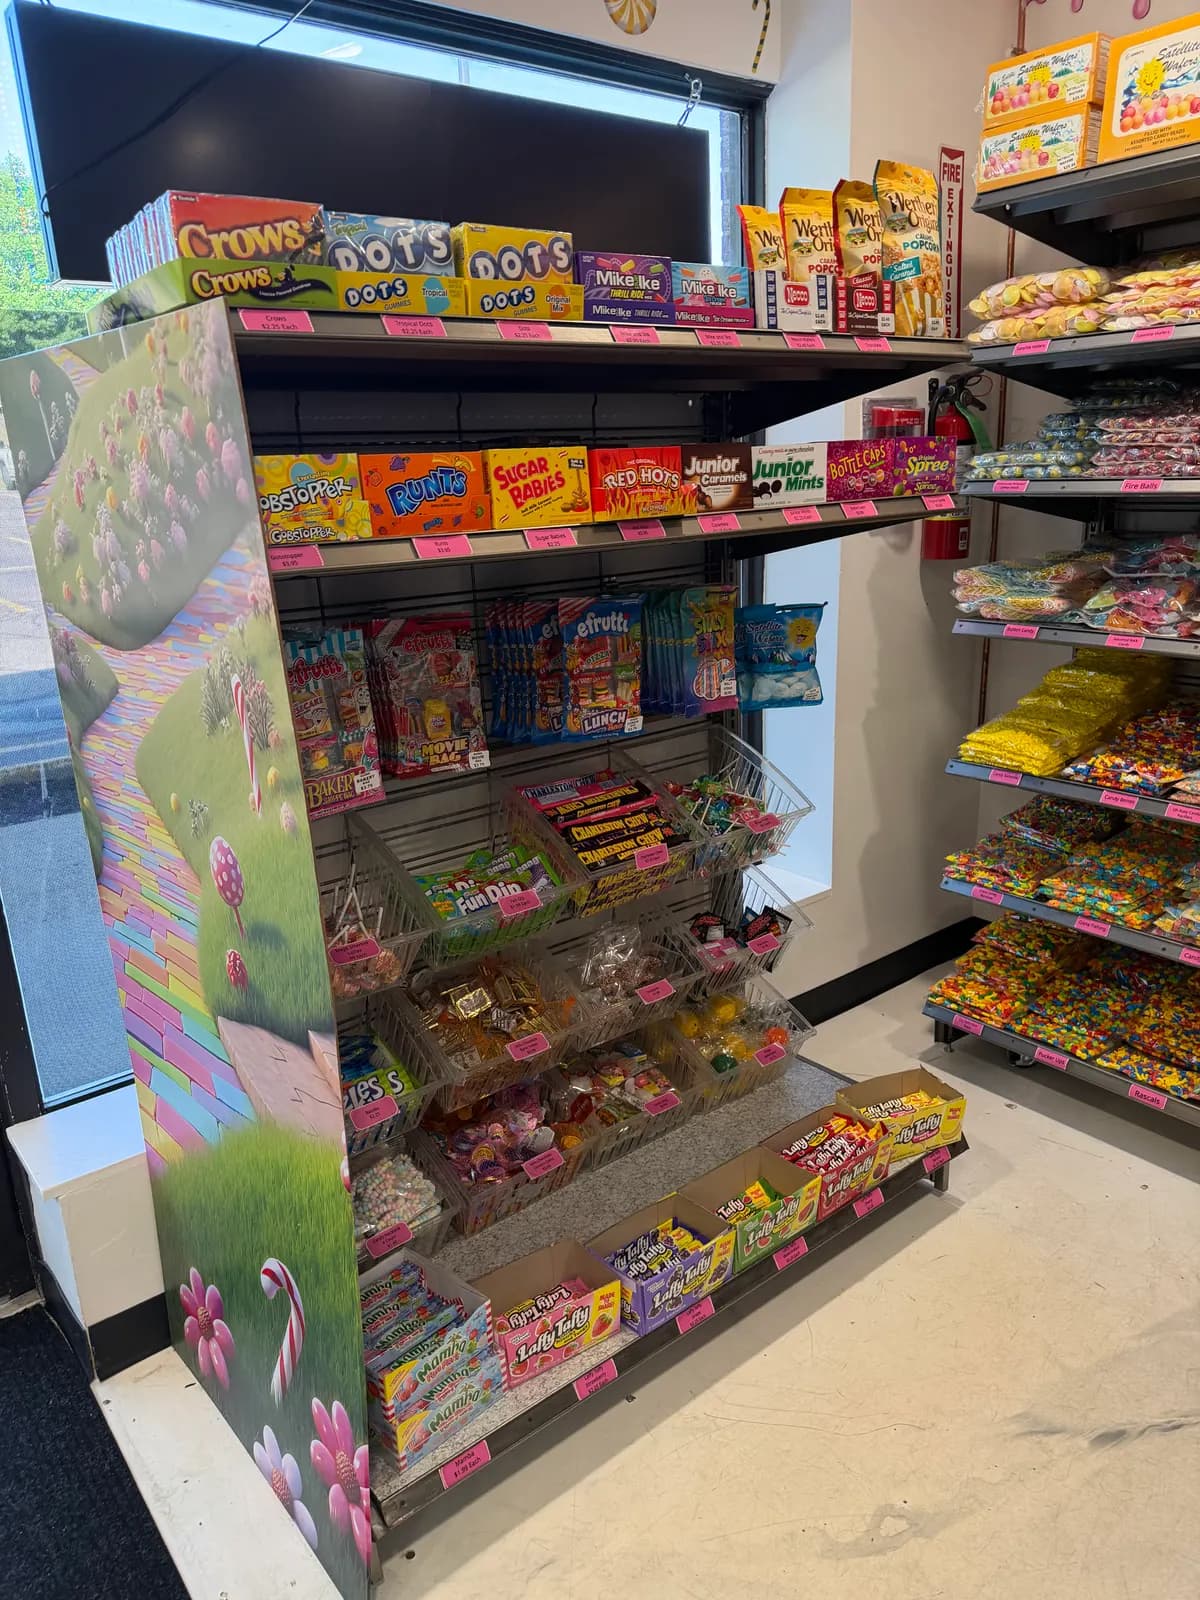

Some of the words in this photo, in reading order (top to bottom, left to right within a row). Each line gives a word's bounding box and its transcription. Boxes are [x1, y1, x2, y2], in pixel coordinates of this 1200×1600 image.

[1051, 52, 1078, 65] Wafers
[1162, 56, 1199, 73] Wafers
[1041, 122, 1068, 133] Wafers
[942, 162, 961, 184] FIRE
[177, 219, 306, 261] Crows
[333, 225, 450, 272] DOTS
[472, 240, 571, 280] DOTS
[893, 261, 914, 273] Salted
[191, 266, 273, 299] Crows
[596, 269, 635, 289] Mike
[638, 274, 661, 291] Ike
[889, 267, 917, 281] Caramel
[345, 277, 408, 307] DOTS
[421, 287, 449, 298] Tropical
[481, 285, 535, 313] DOTS
[545, 295, 571, 305] Original
[609, 288, 630, 299] THRILL
[630, 289, 646, 300] RIDE
[681, 279, 715, 296] Mike
[718, 284, 738, 299] Ike
[786, 286, 809, 304] Necco
[855, 291, 876, 308] Necco
[384, 300, 412, 311] GUMMIES
[551, 302, 565, 313] Mix
[592, 304, 616, 317] Mike
[618, 307, 632, 318] Ike
[281, 323, 298, 331] Each
[675, 311, 697, 322] Mike
[697, 313, 711, 324] Ike
[493, 456, 550, 490] SUGAR
[685, 456, 740, 476] Junior
[752, 457, 814, 481] Junior
[829, 454, 864, 481] BOTTLE
[862, 445, 886, 467] CAPS
[906, 457, 950, 477] Spree
[602, 468, 638, 489] RED
[640, 465, 682, 491] HOTS
[701, 473, 748, 487] Caramels
[784, 475, 825, 492] Mints
[1140, 482, 1158, 490] Balls
[258, 476, 354, 515] OBSTOPPER
[386, 466, 468, 517] RUNTS
[508, 470, 566, 510] BABIES
[271, 525, 338, 544] GOBSTOPPER
[577, 611, 629, 637] efrutti
[746, 620, 784, 633] Satellite
[753, 631, 785, 645] Wafers
[583, 711, 627, 733] LUNCH
[421, 737, 468, 755] MOVIE
[429, 751, 462, 766] BAG
[523, 781, 574, 799] CHARLESTON
[575, 774, 597, 787] CHEW
[1104, 794, 1119, 802] Candy
[571, 819, 625, 842] CHARLESTON
[624, 812, 649, 827] CHEW
[577, 839, 637, 865] CHARLESTON
[636, 827, 665, 847] CHEW
[456, 892, 489, 916] Fun
[484, 881, 523, 904] Dip
[1134, 1089, 1160, 1105] Rascals
[914, 1113, 942, 1132] Taffy
[827, 1173, 852, 1198] Laffy
[852, 1155, 875, 1176] Taffy
[719, 1197, 745, 1219] Taffy
[748, 1217, 776, 1246] Laffy
[775, 1198, 800, 1223] Taffy
[626, 1236, 649, 1262] Taffy
[637, 1241, 668, 1264] Taffy
[653, 1279, 685, 1309] Laffy
[684, 1256, 711, 1284] Taffy
[535, 1285, 572, 1310] Laffy
[599, 1291, 616, 1301] MADE
[375, 1317, 426, 1350] Mamba
[516, 1329, 556, 1363] Laffy
[554, 1305, 590, 1338] Taffy
[416, 1337, 468, 1383] Mamba
[423, 1365, 471, 1401] Mamba
[428, 1387, 482, 1433] Mamba
[453, 1465, 469, 1479] $1.99
[468, 1457, 482, 1469] Each
[454, 1451, 476, 1468] Mamba
